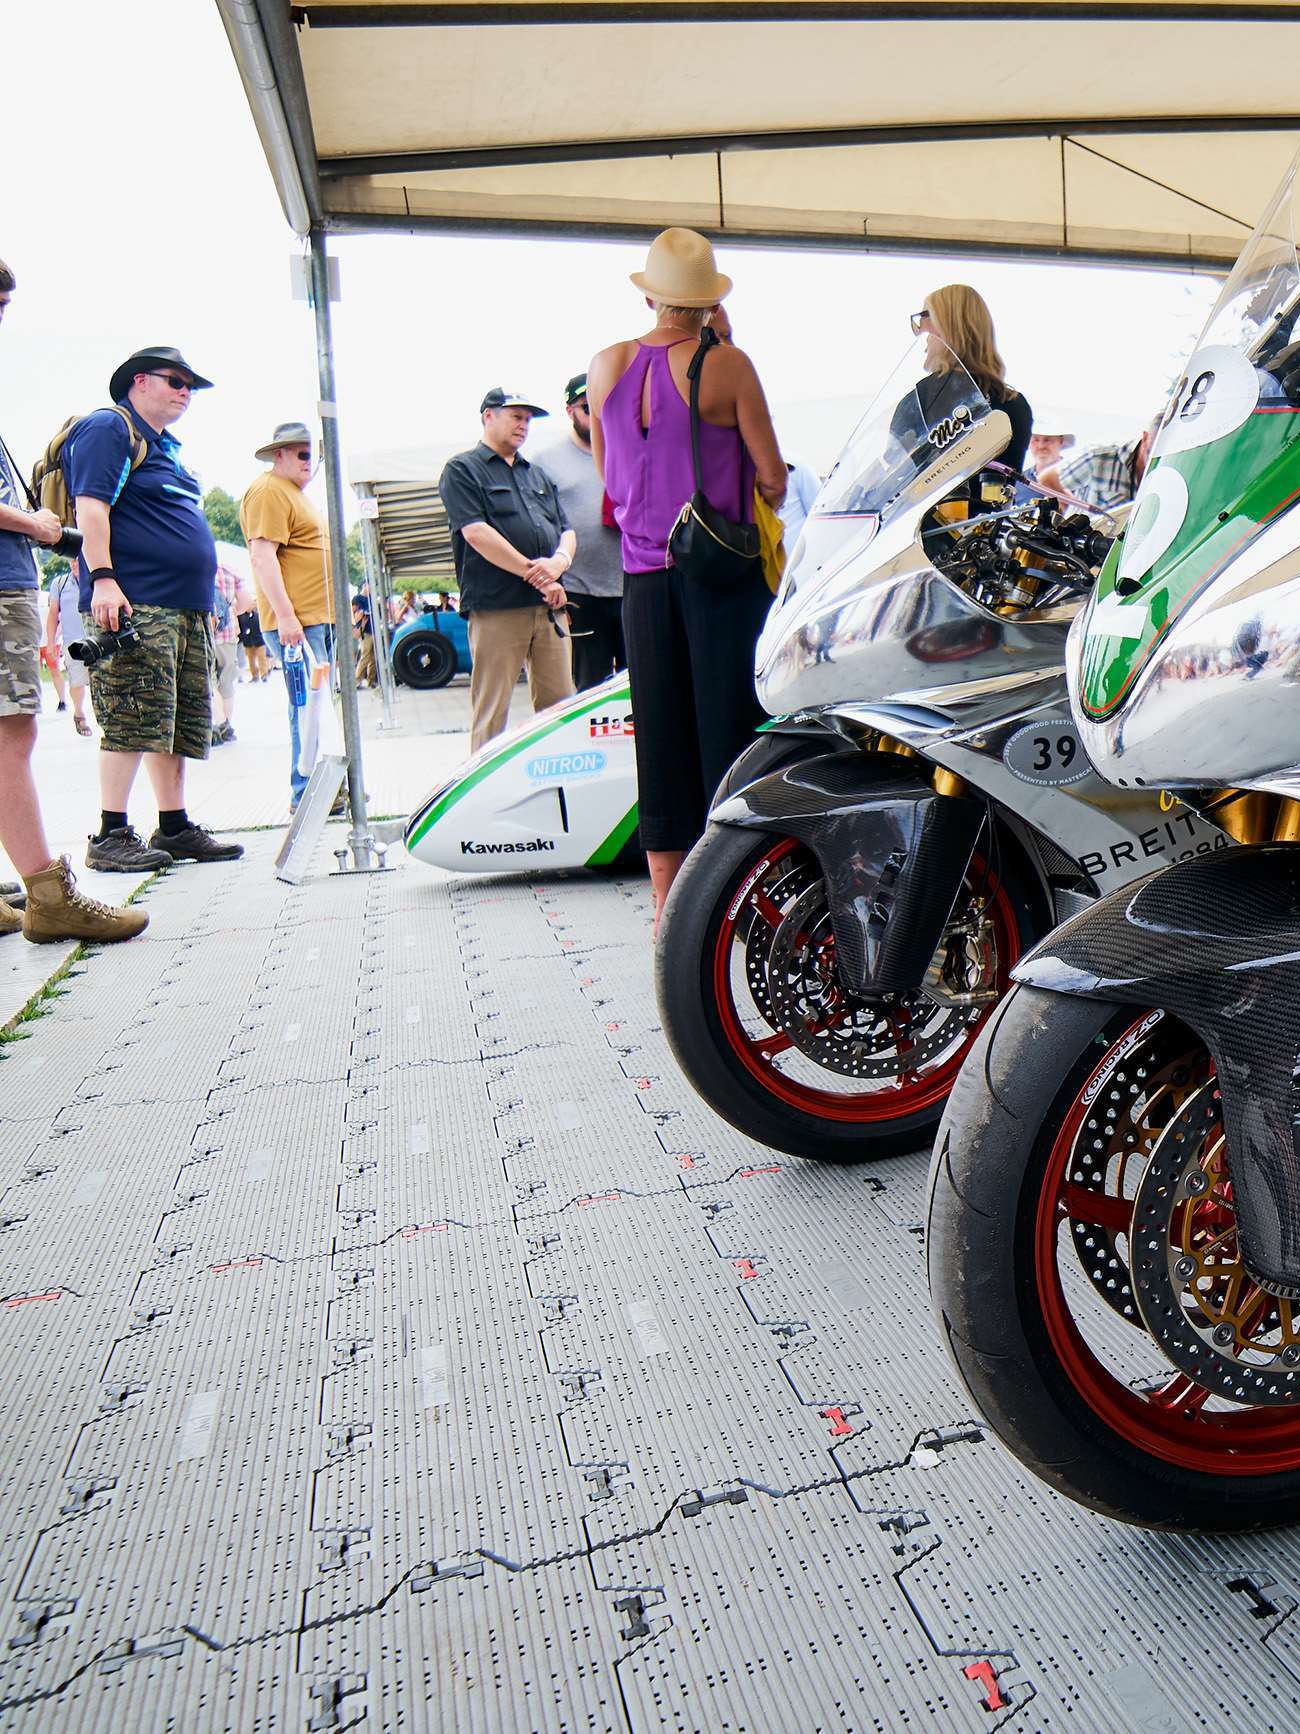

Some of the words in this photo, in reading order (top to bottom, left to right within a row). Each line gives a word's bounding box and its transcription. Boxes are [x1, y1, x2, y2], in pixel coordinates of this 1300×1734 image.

[925, 446, 972, 485] BREITLING
[1011, 720, 1049, 742] GOODWOOD
[532, 755, 596, 776] NITRON
[1033, 736, 1076, 770] 39
[1013, 769, 1047, 785] PRESENTED
[1059, 767, 1093, 785] MASTERCA
[461, 839, 554, 854] Kawasaki
[1078, 811, 1197, 877] BREIT
[1089, 1039, 1130, 1090] RACING
